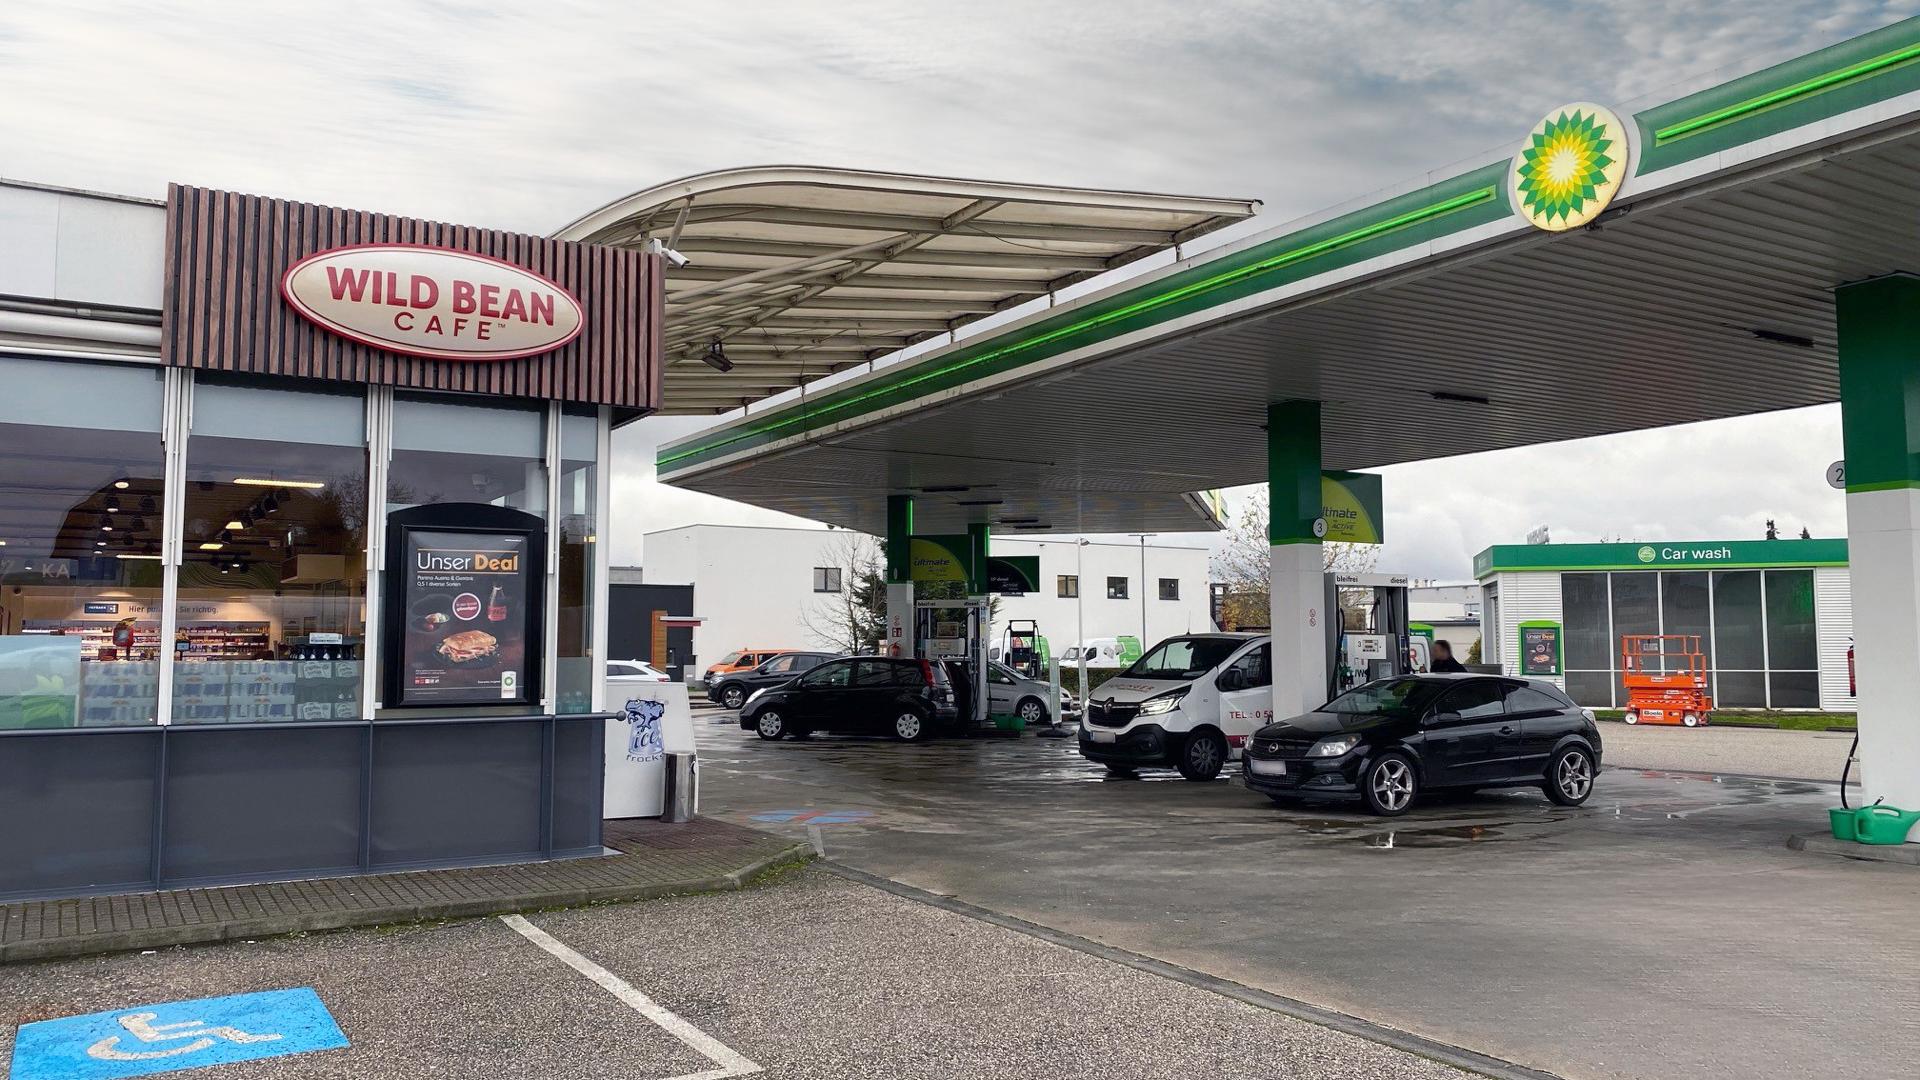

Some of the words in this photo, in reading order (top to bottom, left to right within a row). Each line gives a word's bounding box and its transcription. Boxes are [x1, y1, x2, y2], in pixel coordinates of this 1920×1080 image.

[326, 266, 439, 310] WILD
[453, 280, 554, 326] BEAN
[394, 311, 491, 340] CAFE
[1835, 467, 1844, 482] 2
[1322, 506, 1357, 519] ltimate
[1317, 522, 1323, 533] 3
[1662, 547, 1687, 560] Car
[1692, 546, 1731, 559] wash
[417, 552, 471, 570] Unser
[474, 553, 518, 571] Deal
[1336, 575, 1358, 583] bleifrei
[129, 605, 144, 613] Hier
[1229, 711, 1247, 719] TEL
[1255, 710, 1261, 719] 0
